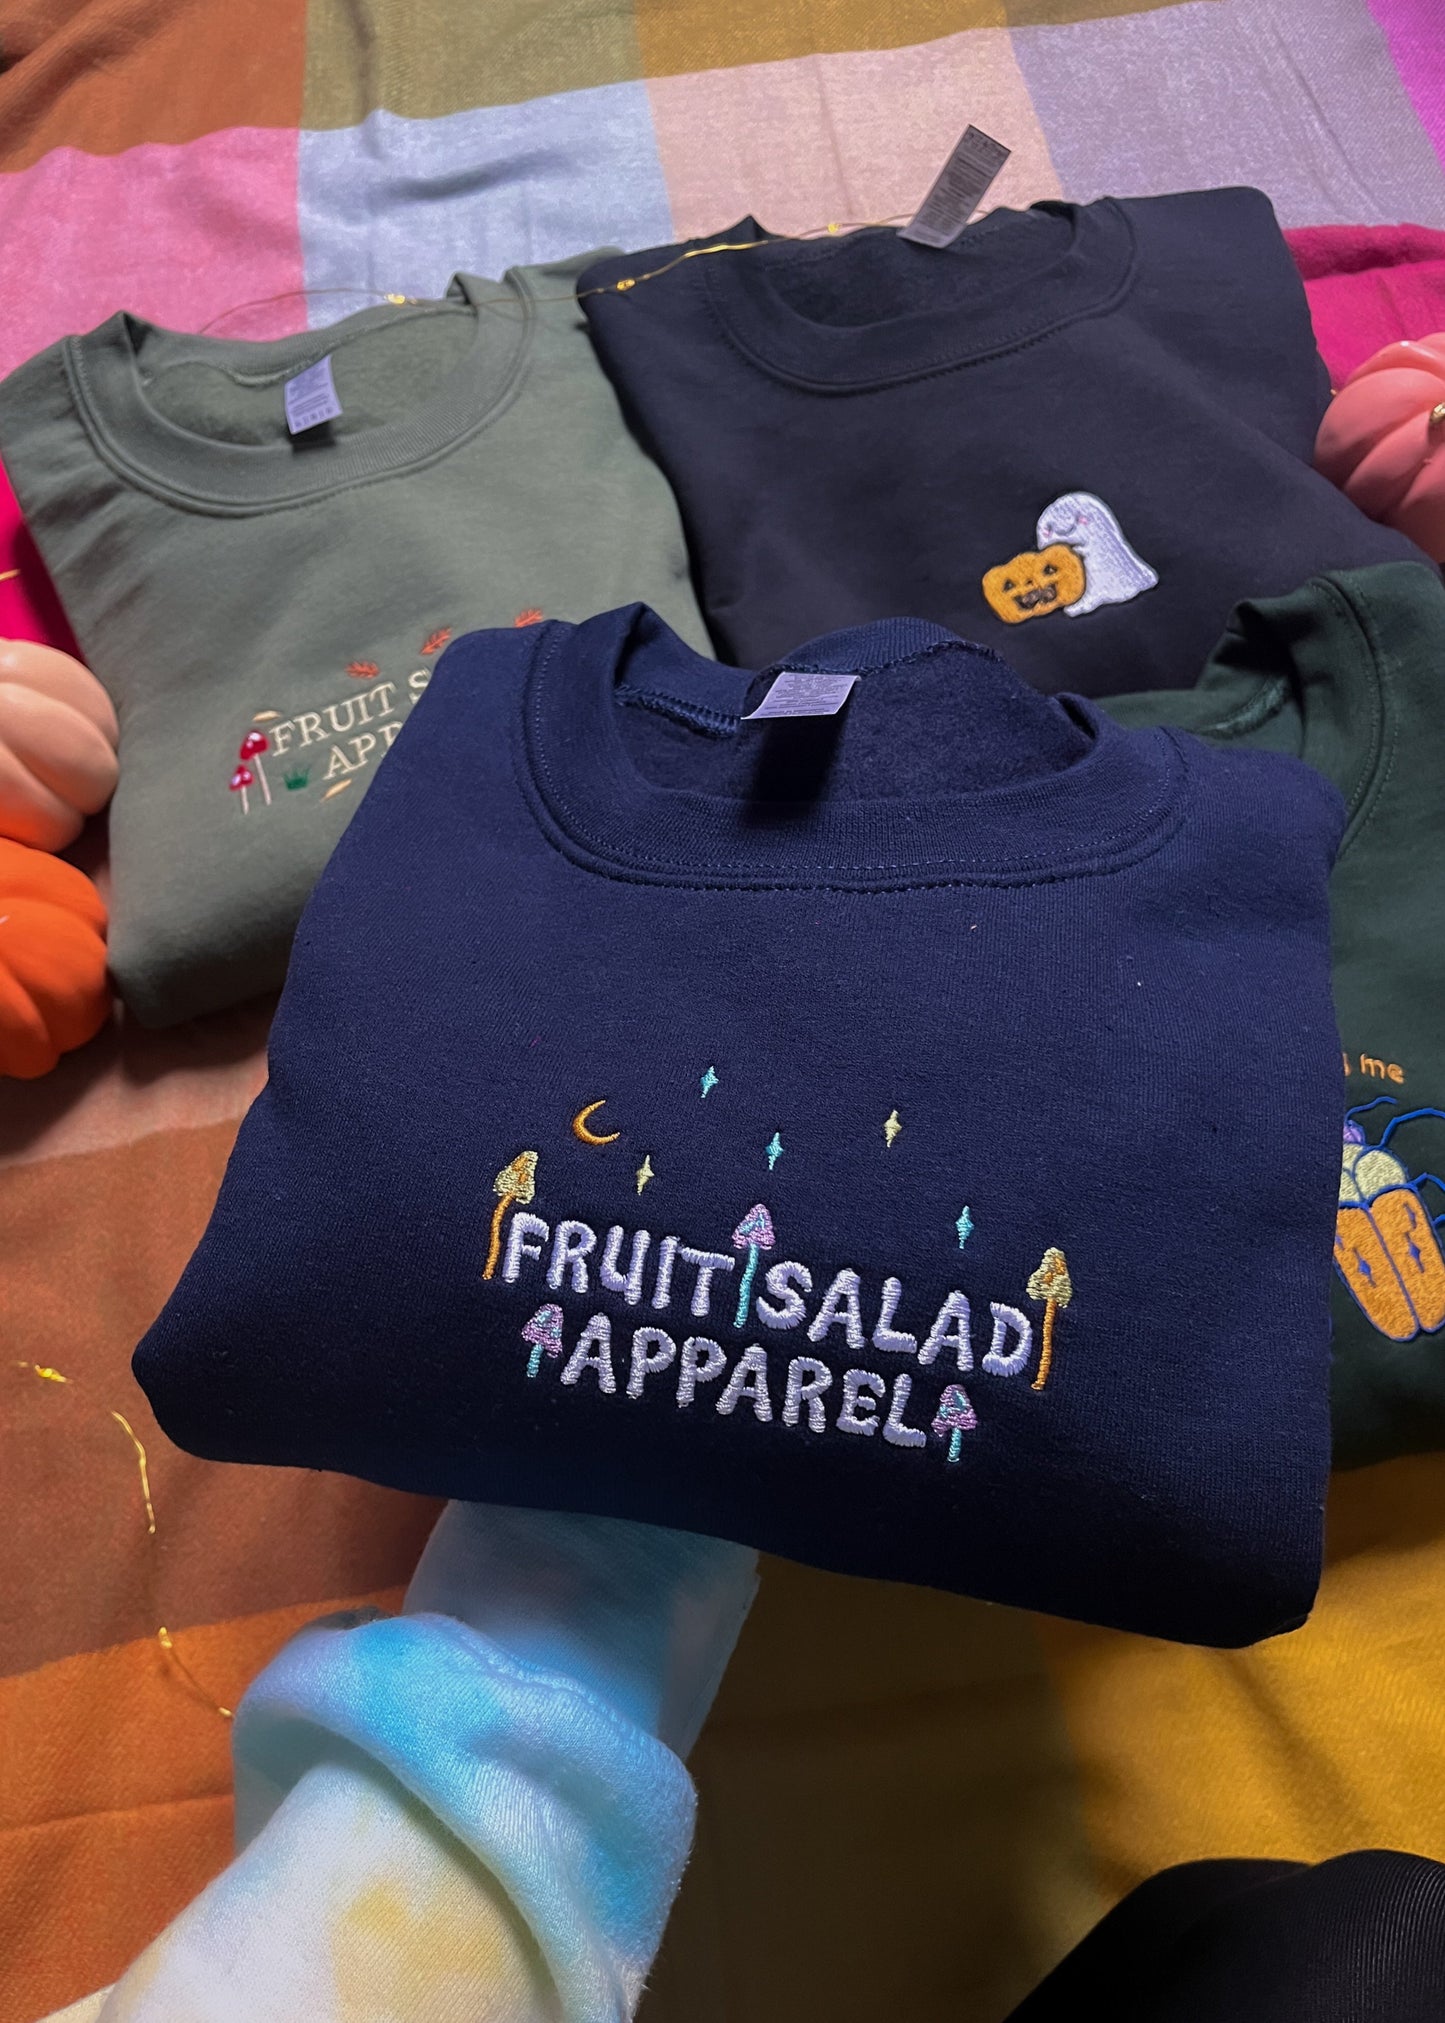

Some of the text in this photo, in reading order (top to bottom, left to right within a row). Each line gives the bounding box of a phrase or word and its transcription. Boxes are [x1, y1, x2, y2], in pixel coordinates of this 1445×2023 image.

[268, 681, 397, 757] FRUIT
[1360, 1052, 1405, 1085] me
[501, 1211, 1033, 1378] FRUIT SALAD
[560, 1312, 927, 1448] APPAREL
